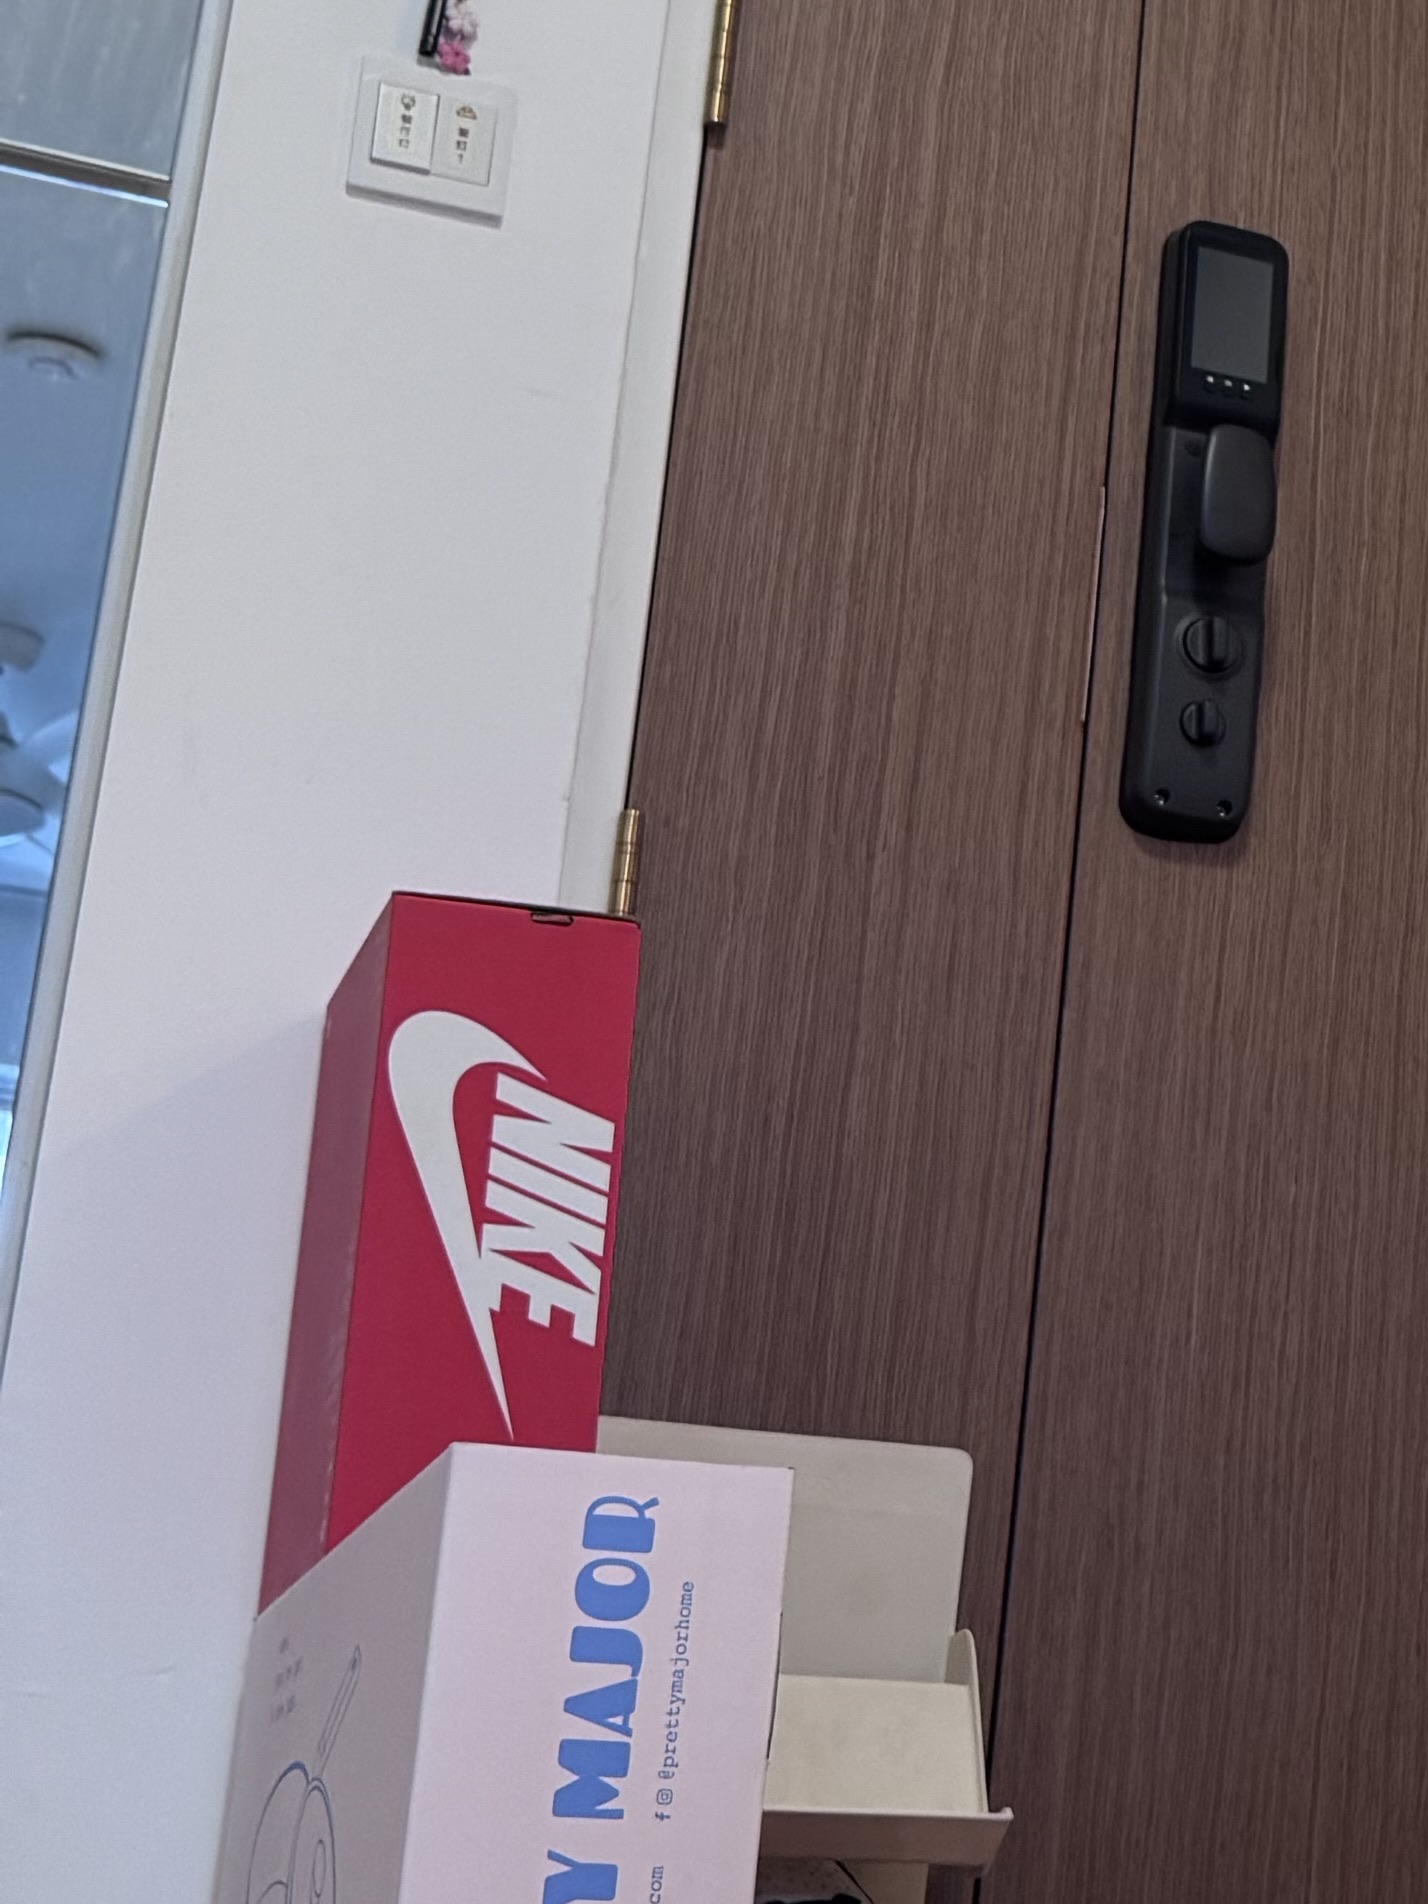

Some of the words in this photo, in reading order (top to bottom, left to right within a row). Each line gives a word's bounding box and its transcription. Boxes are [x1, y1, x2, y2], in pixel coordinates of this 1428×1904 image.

[483, 1072, 615, 1348] NIKE
[553, 1495, 660, 1820] MAJOR
[658, 1580, 695, 1780] @prettymajorhome
